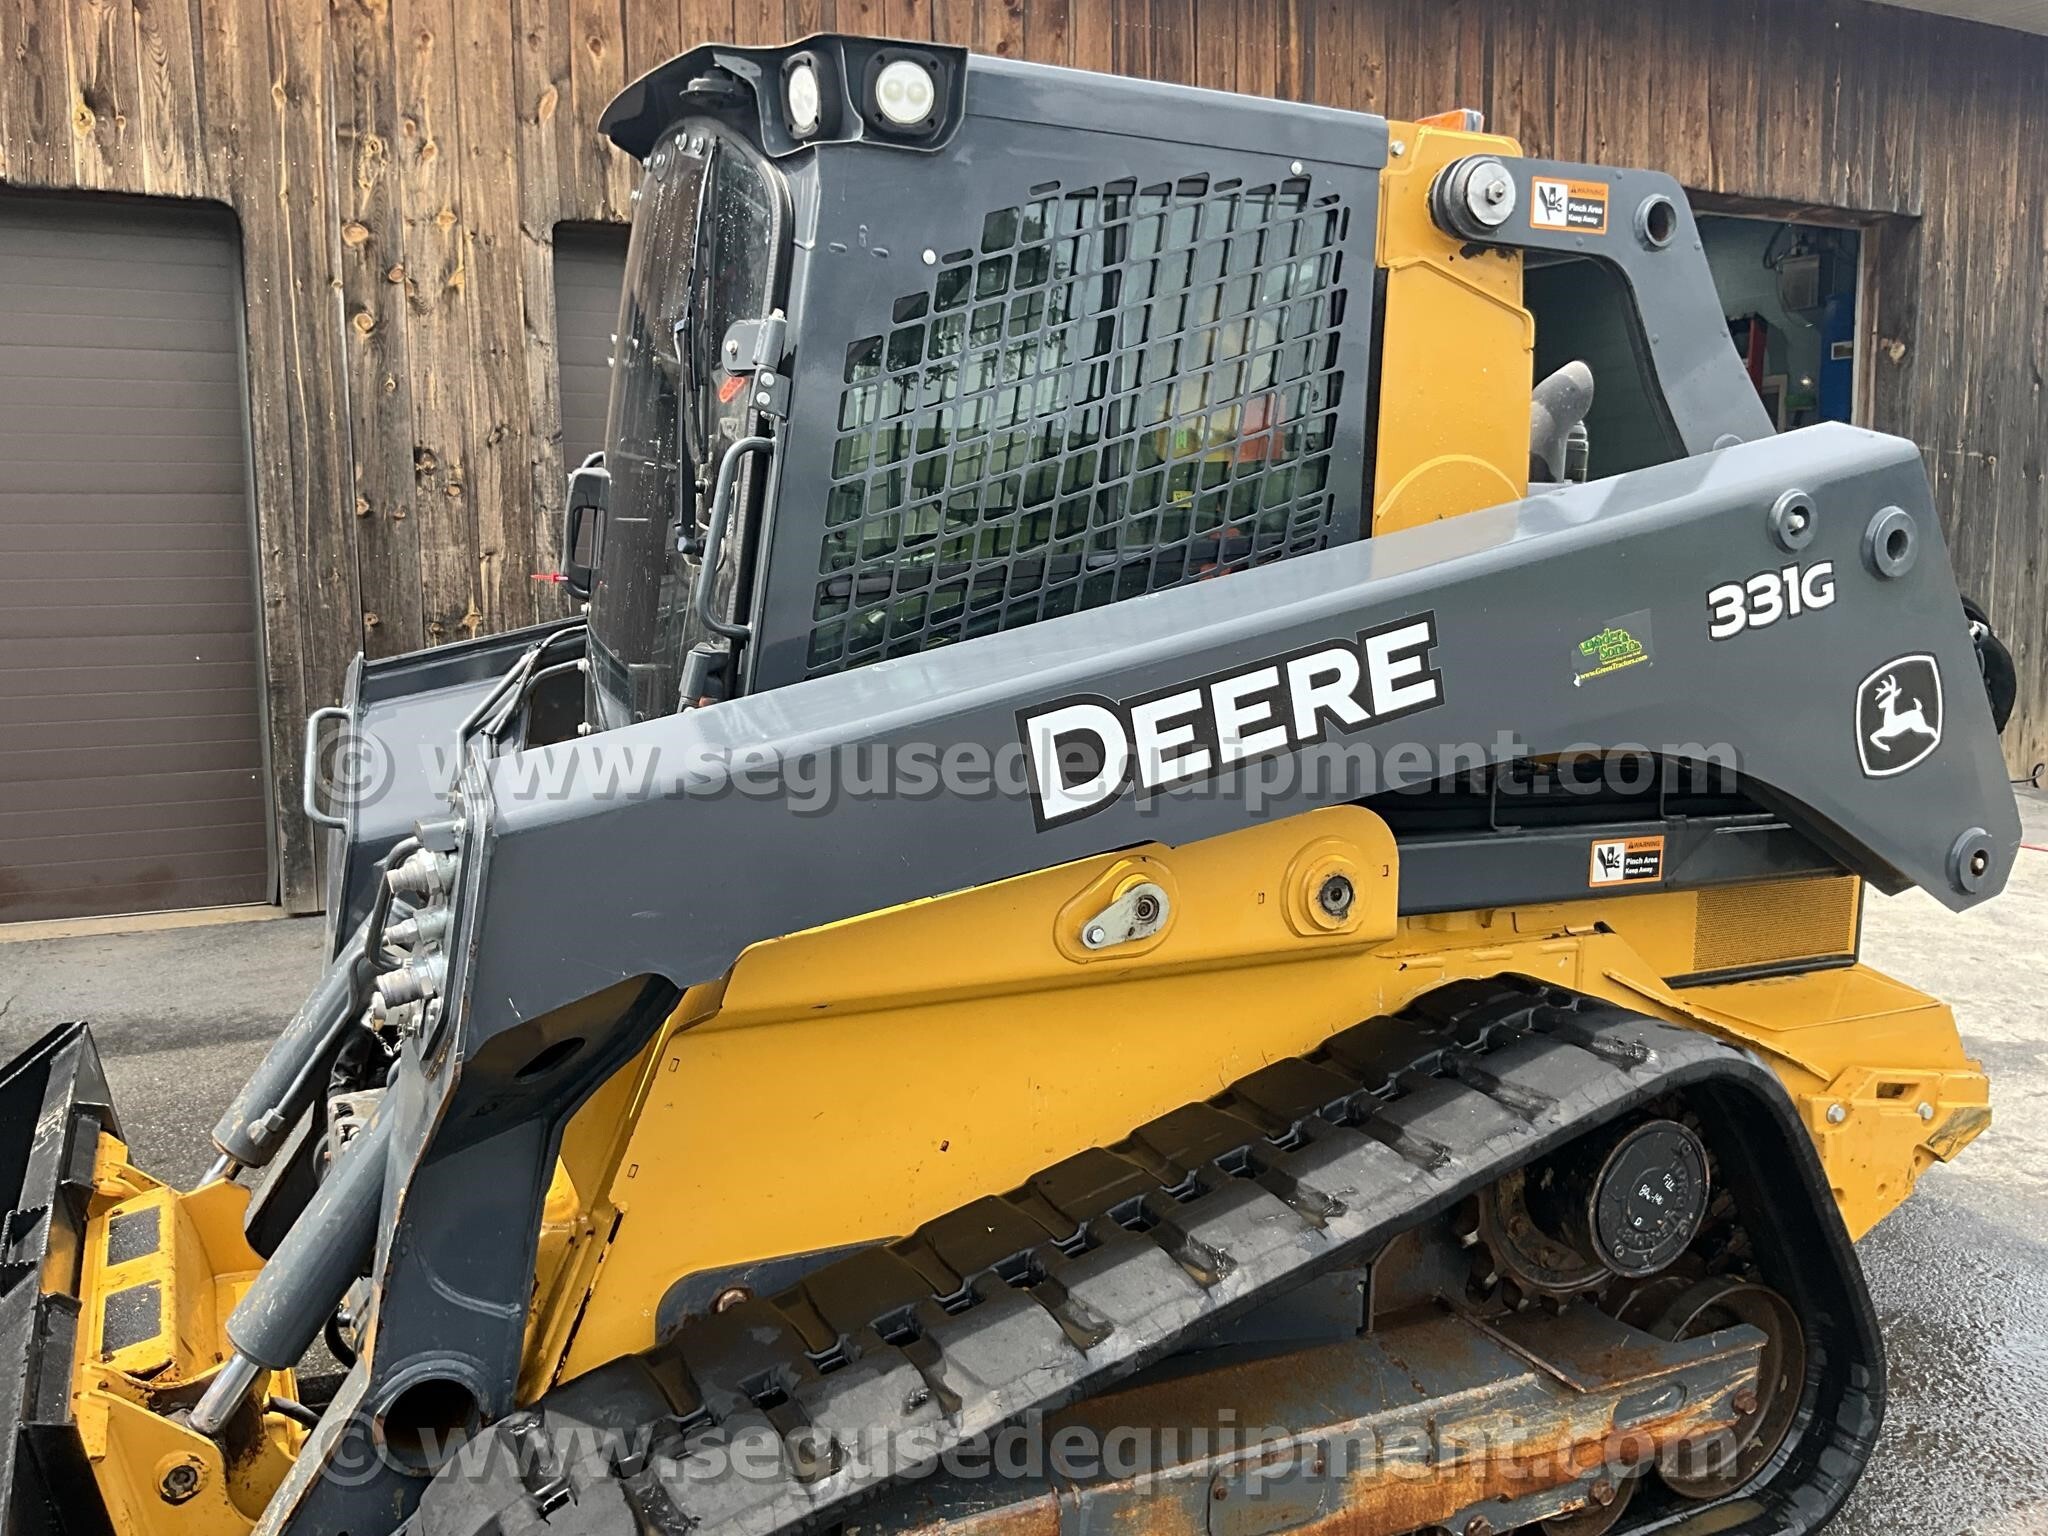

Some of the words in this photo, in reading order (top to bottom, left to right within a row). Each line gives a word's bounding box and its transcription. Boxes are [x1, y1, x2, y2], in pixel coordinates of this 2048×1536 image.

[1568, 203, 1587, 213] Pinch
[1588, 205, 1603, 214] Area
[1708, 561, 1835, 638] 331G
[1600, 643, 1628, 660] Sons
[1580, 655, 1648, 679] www.GreenTractors.com
[1026, 621, 1438, 820] DEERE
[1633, 840, 1661, 849] WARNING
[1625, 857, 1643, 866] Pinch
[1643, 856, 1659, 864] Area
[1625, 867, 1639, 875] Keep
[1638, 866, 1654, 874] Away
